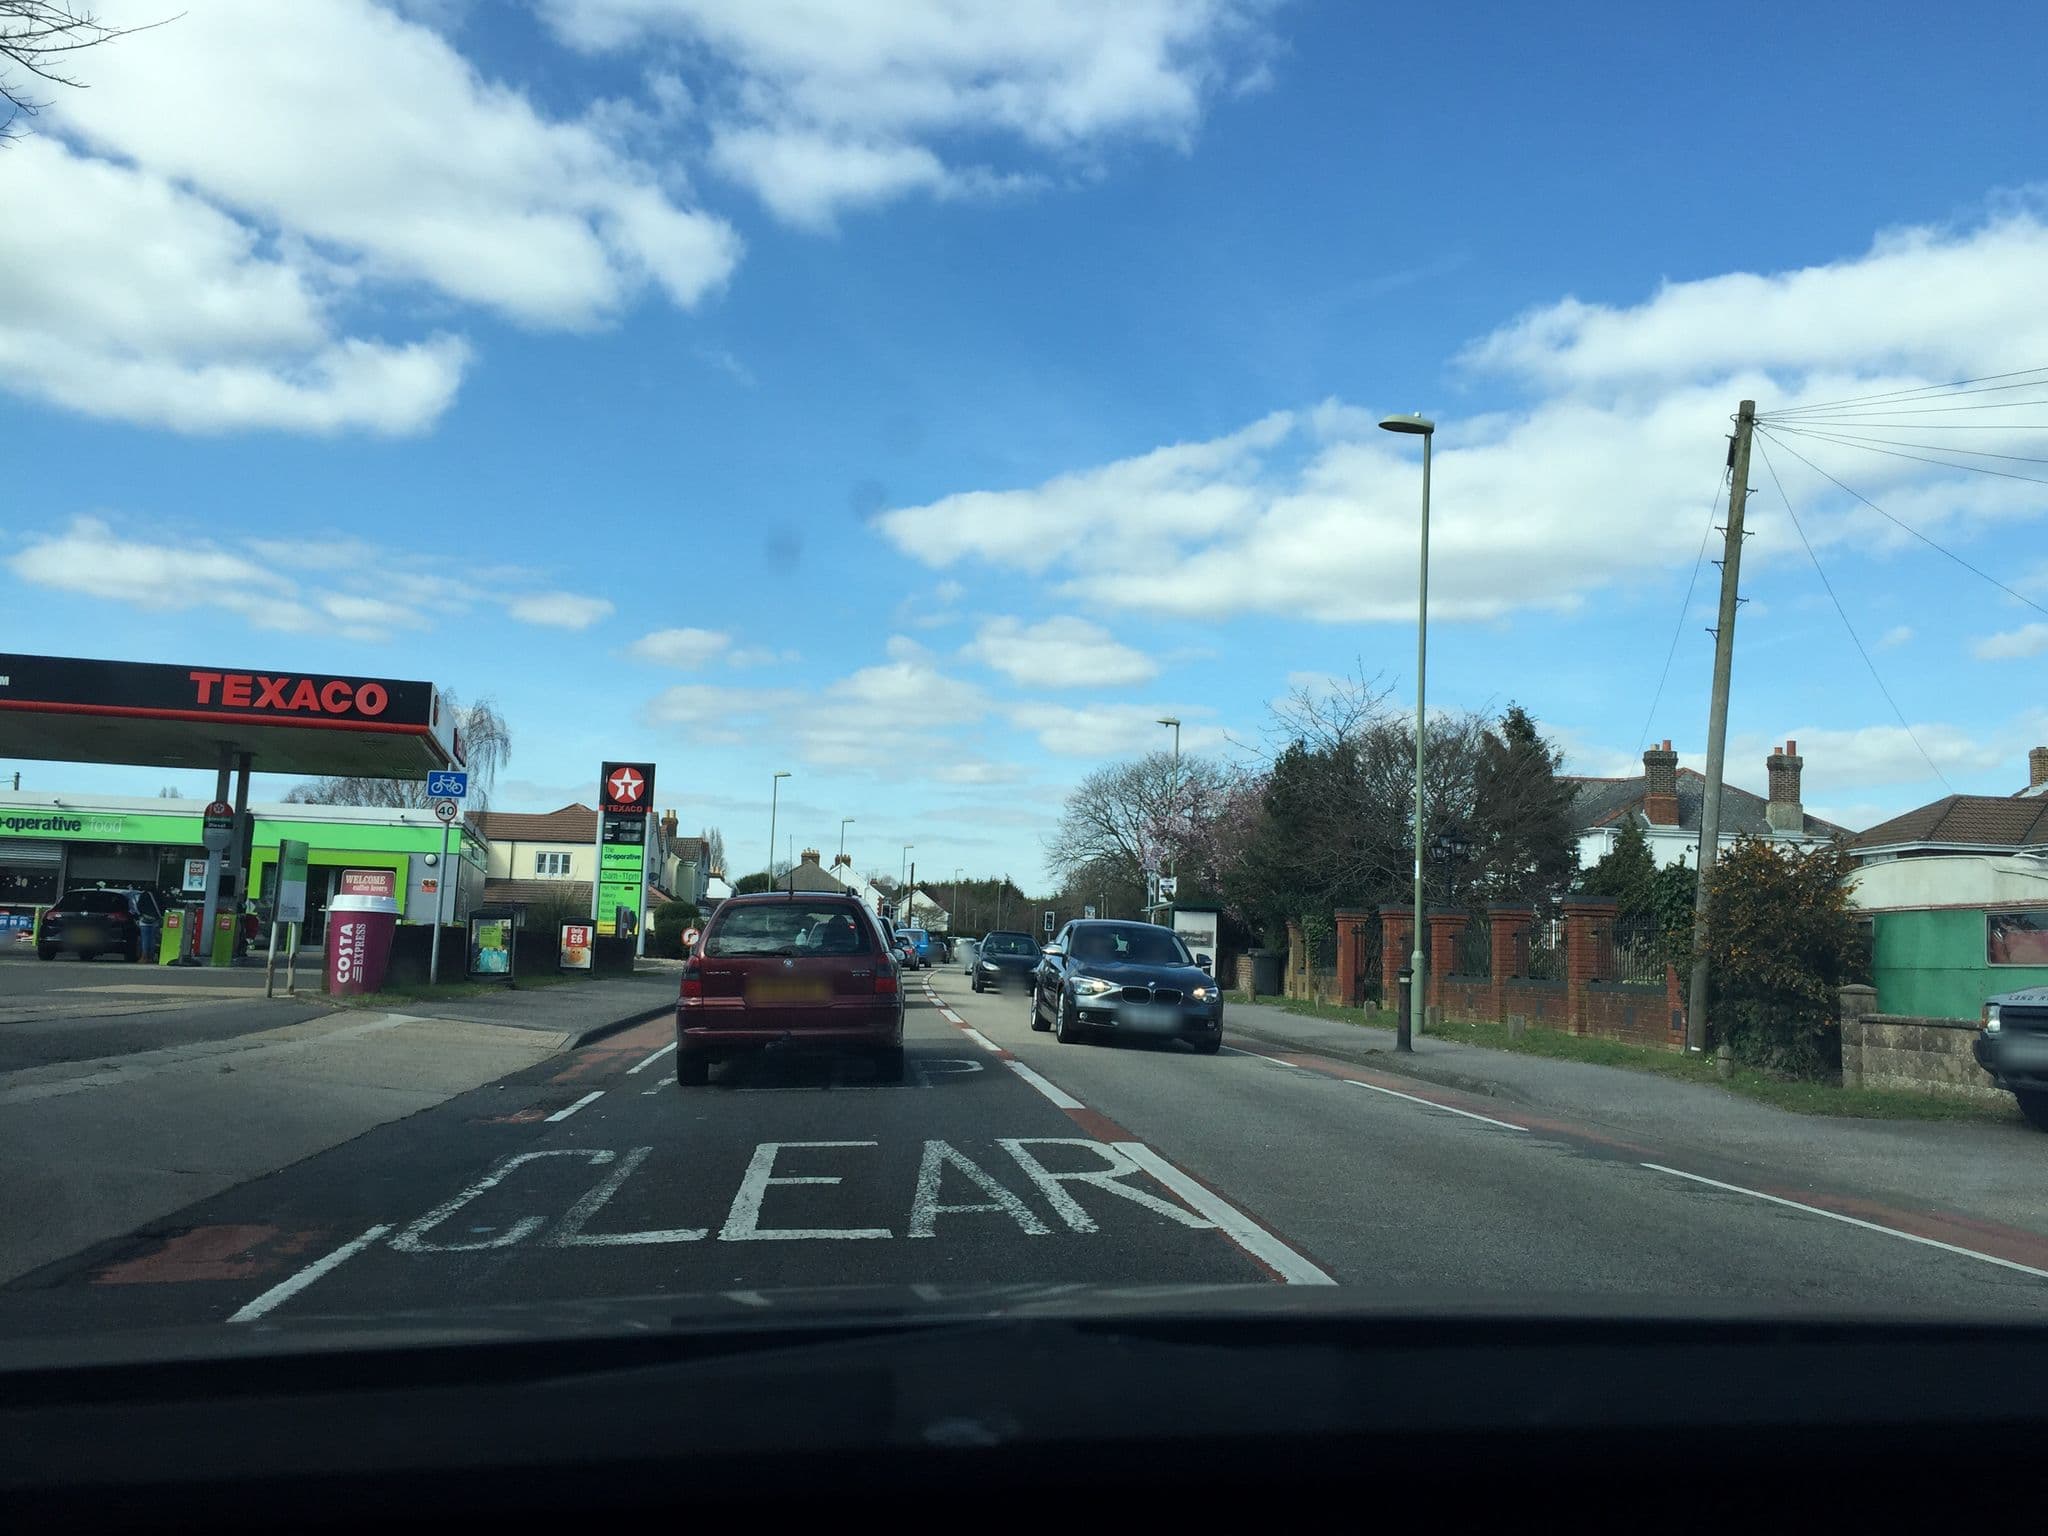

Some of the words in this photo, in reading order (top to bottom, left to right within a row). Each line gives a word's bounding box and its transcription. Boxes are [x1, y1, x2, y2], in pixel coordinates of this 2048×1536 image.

[190, 671, 388, 716] TEXACO
[438, 806, 454, 816] 40
[607, 805, 643, 813] TEXACO
[90, 817, 122, 833] food
[346, 875, 386, 885] WELCOME
[337, 923, 354, 983] COSTA
[354, 923, 366, 965] EXPRESS
[388, 1138, 1219, 1253] CLEAR
